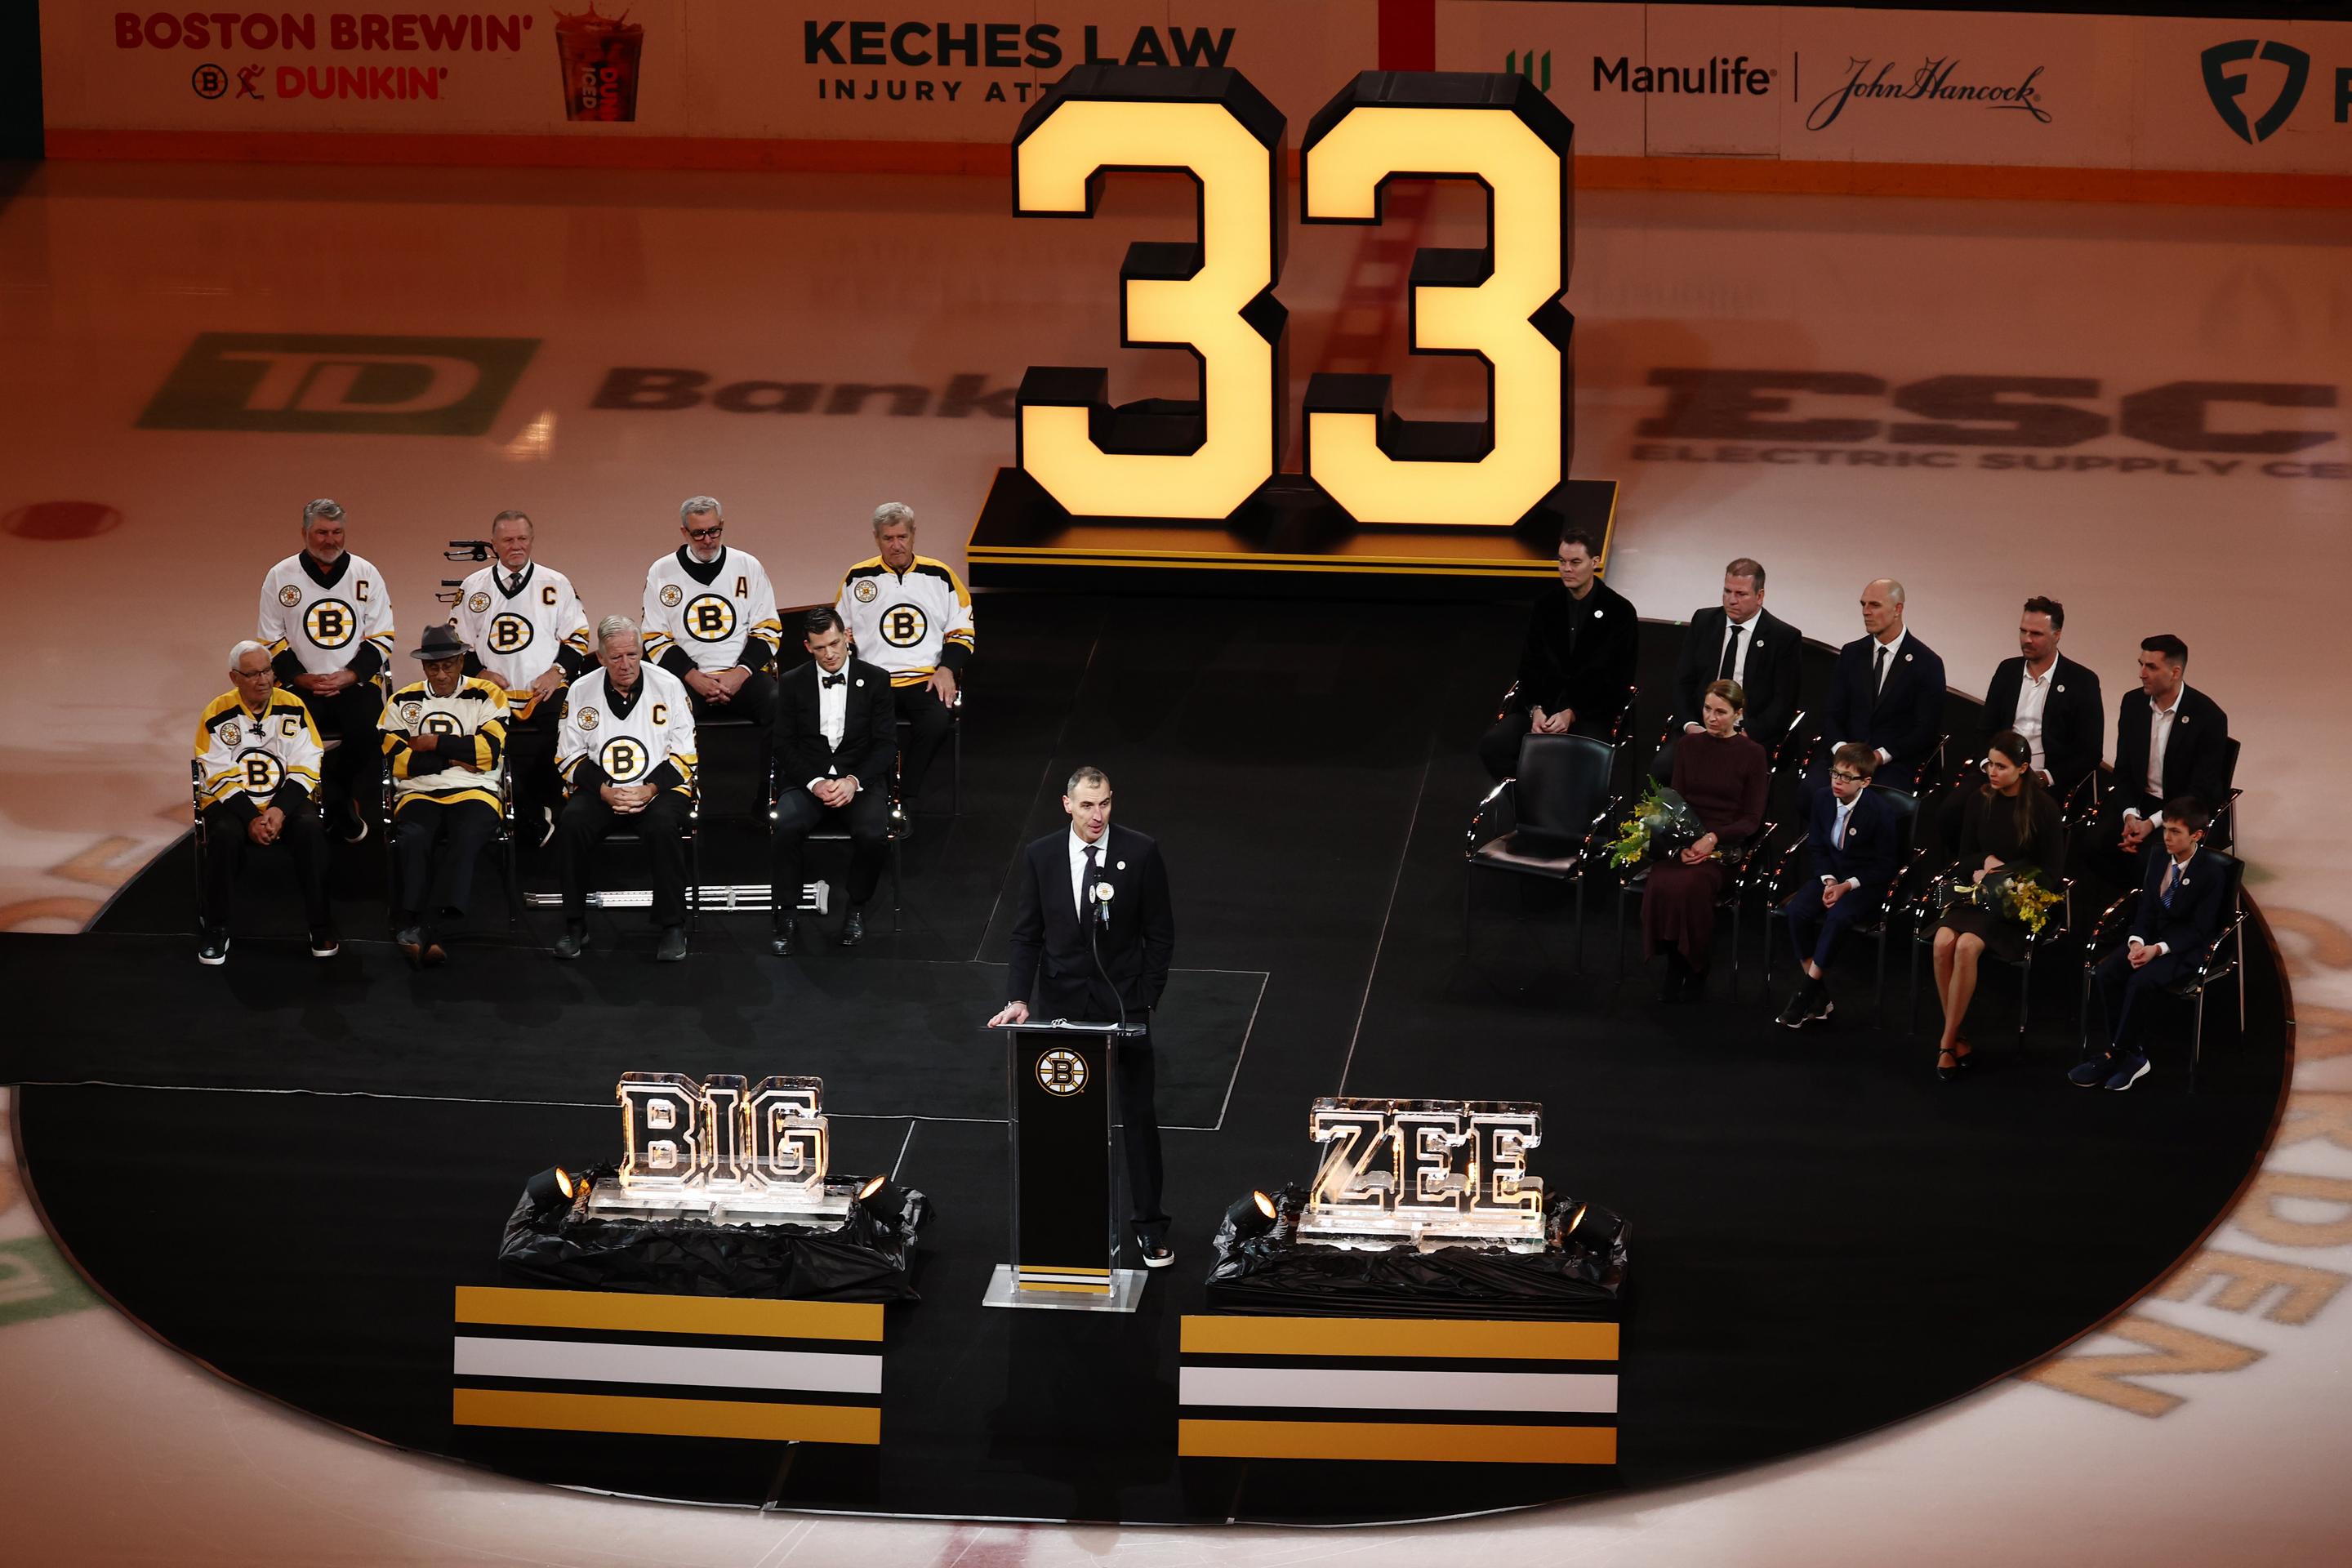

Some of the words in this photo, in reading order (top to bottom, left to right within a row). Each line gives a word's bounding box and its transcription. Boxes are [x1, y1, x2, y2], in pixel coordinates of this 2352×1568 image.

[114, 12, 316, 50] BOSTON
[330, 16, 533, 51] BREWIN'
[804, 20, 1062, 69] KECHES
[1084, 25, 1236, 68] LAW
[276, 65, 448, 100] DUNKIN'
[581, 67, 597, 109] ICED
[818, 78, 963, 101] INJURY
[1593, 56, 1772, 96] Manulife
[1806, 56, 1905, 131] John
[1903, 56, 2052, 124] Hancock
[1013, 95, 1568, 531] 33
[214, 351, 482, 414] TD
[593, 367, 1018, 421] Bank
[1636, 367, 2339, 455] ESC
[1633, 443, 1962, 470] ELECTRIC
[1980, 451, 2241, 478] SUPPLY
[357, 581, 368, 602] C
[542, 586, 556, 605] C
[736, 577, 748, 599] A
[318, 610, 343, 637] B
[498, 621, 519, 646] B
[697, 605, 723, 632] B
[893, 612, 915, 639] B
[282, 719, 296, 736] C
[653, 704, 666, 724] C
[247, 760, 270, 786] B
[612, 746, 634, 774] B
[618, 1073, 829, 1194] BIG
[1310, 1098, 1543, 1218] ZEE
